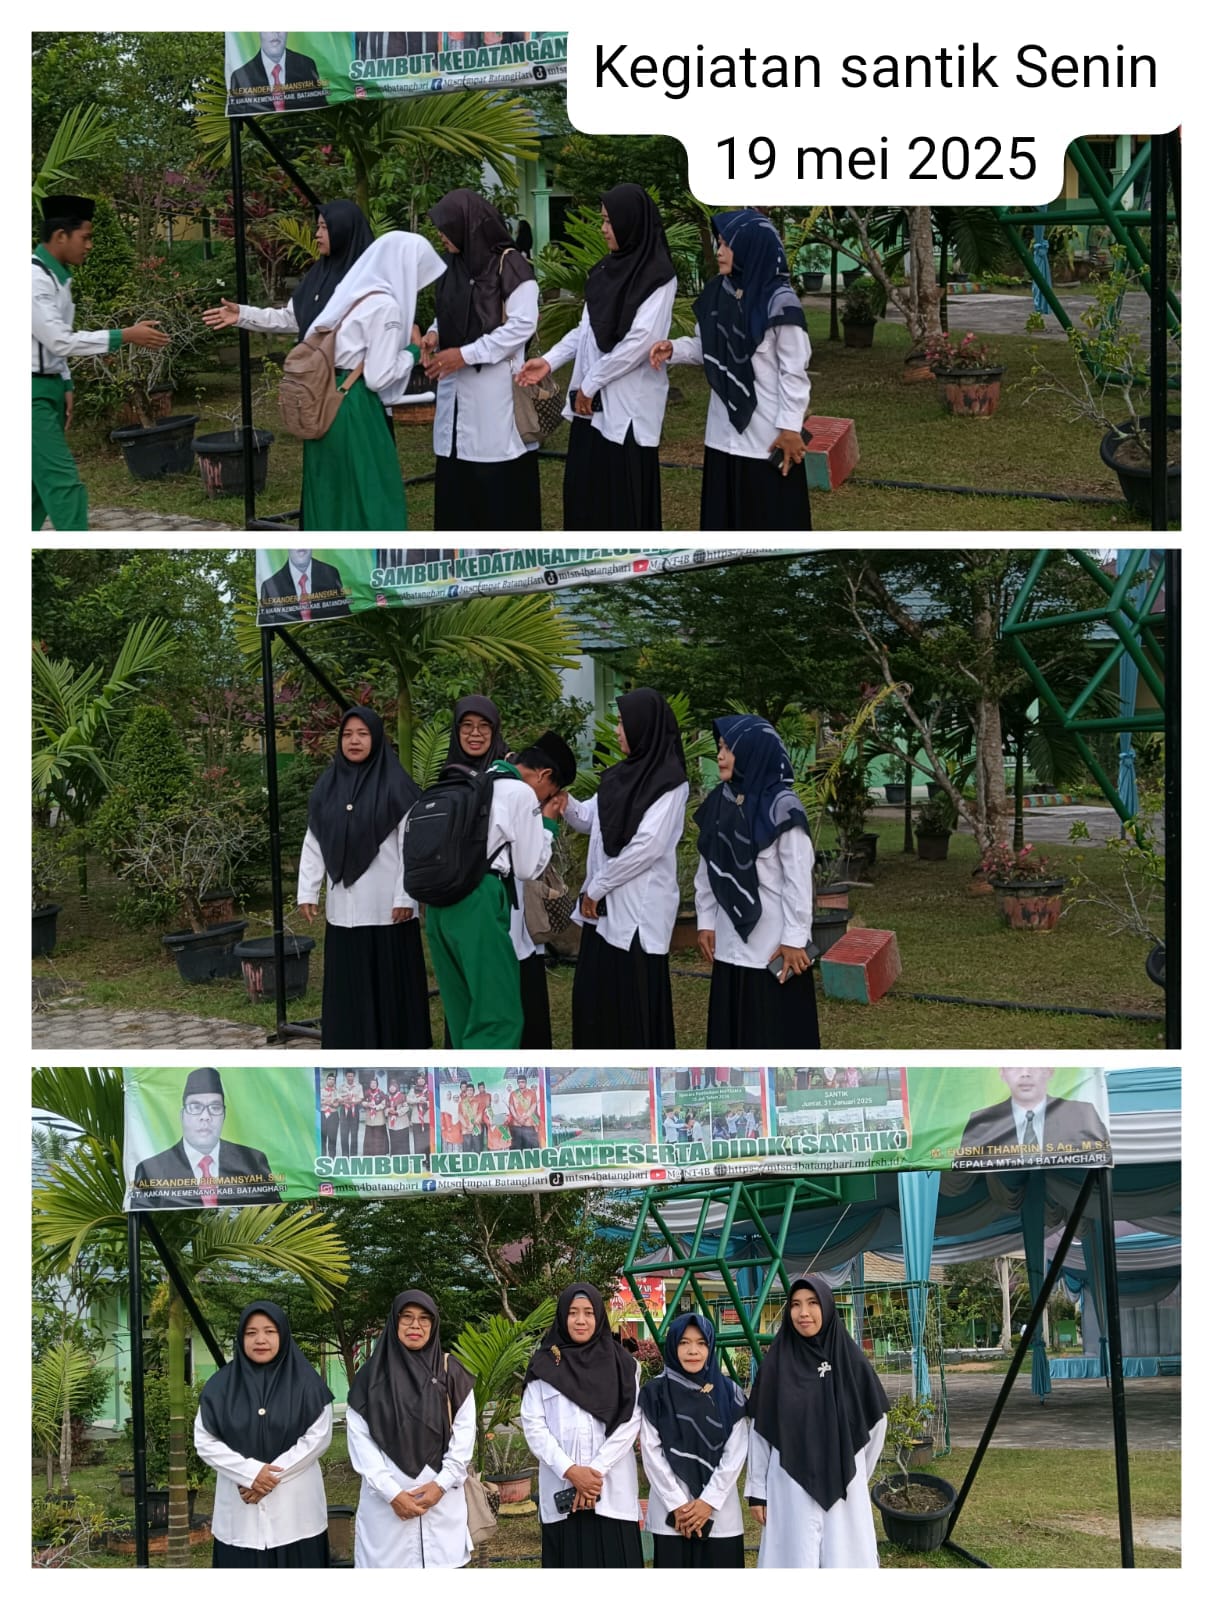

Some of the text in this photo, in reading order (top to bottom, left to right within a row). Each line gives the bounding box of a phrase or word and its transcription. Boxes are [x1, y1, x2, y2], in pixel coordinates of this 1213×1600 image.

[350, 38, 567, 80] SAMBUT KEDATANGAN
[371, 549, 580, 588] SAMBUT KEDATANGAN
[315, 1129, 908, 1177] SAMBUT KEDATANGAN PESERTA DIDIK (SANTIK)
[946, 1146, 984, 1156] HUSNI
[951, 1159, 993, 1169] KEPALA
[1036, 1153, 1106, 1165] BATANGHARI
[139, 1178, 197, 1188] ALEXANDER
[144, 1190, 170, 1198] KAKAN
[237, 1184, 288, 1195] BATANGHARI
[335, 1182, 419, 1193] mtsn4batanghari
[565, 1170, 648, 1183] mtsn4batanghari
